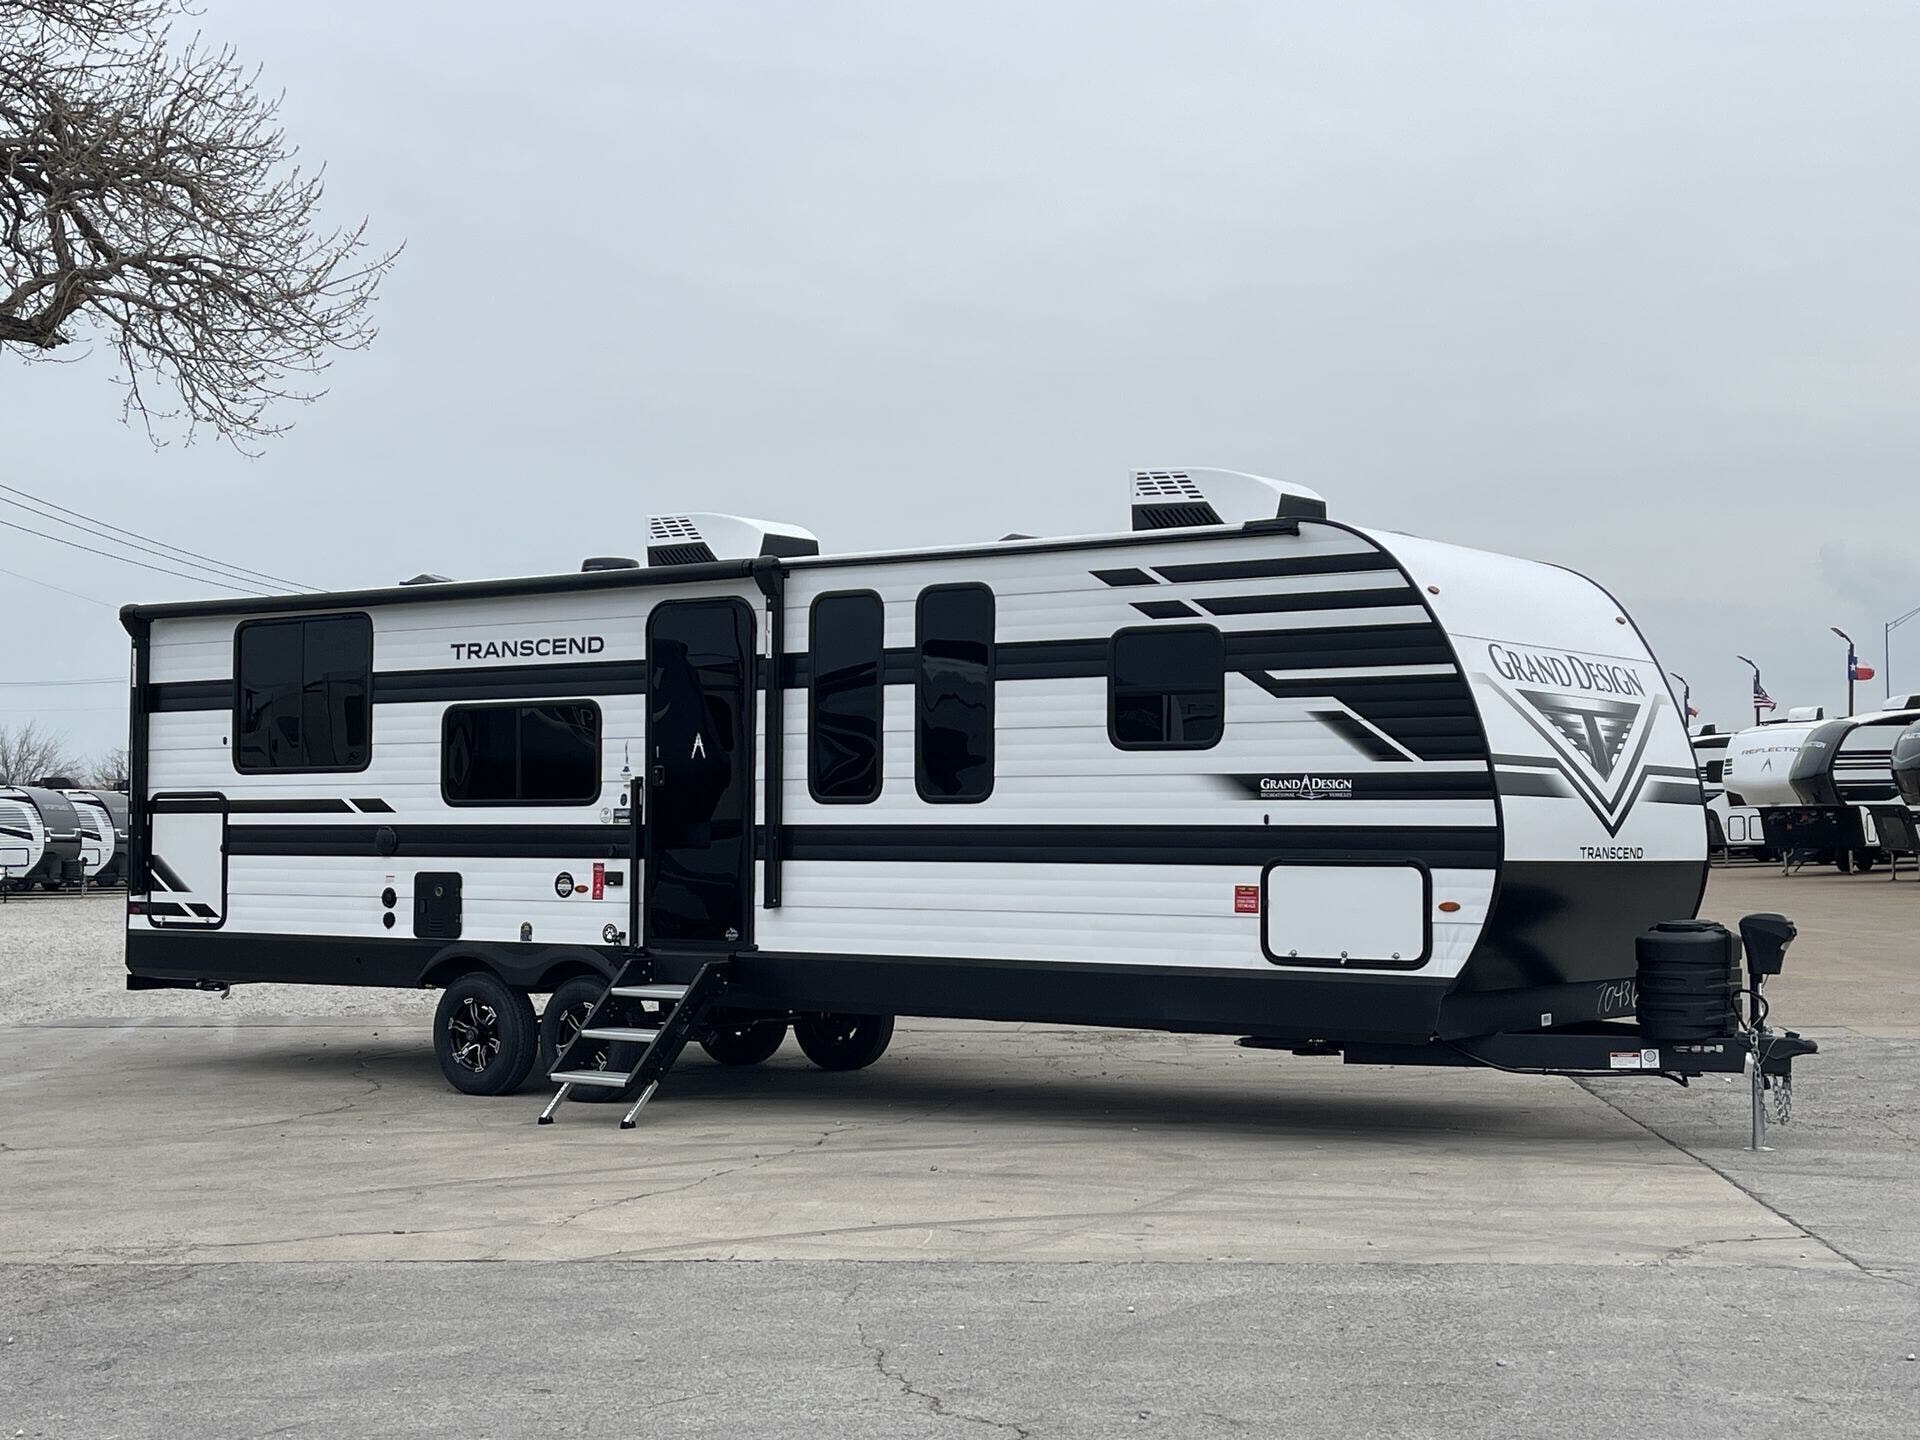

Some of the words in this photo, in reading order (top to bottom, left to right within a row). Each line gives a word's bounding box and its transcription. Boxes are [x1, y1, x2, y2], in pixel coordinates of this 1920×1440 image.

[450, 636, 605, 660] TRANSCEND
[1488, 643, 1572, 687] GRAND
[1565, 654, 1646, 697] DESIGN
[1741, 746, 1801, 756] REFLECTIO
[1260, 778, 1301, 789] GRAND
[1312, 778, 1353, 789] DESIGN
[1579, 846, 1644, 859] TRANSCEND
